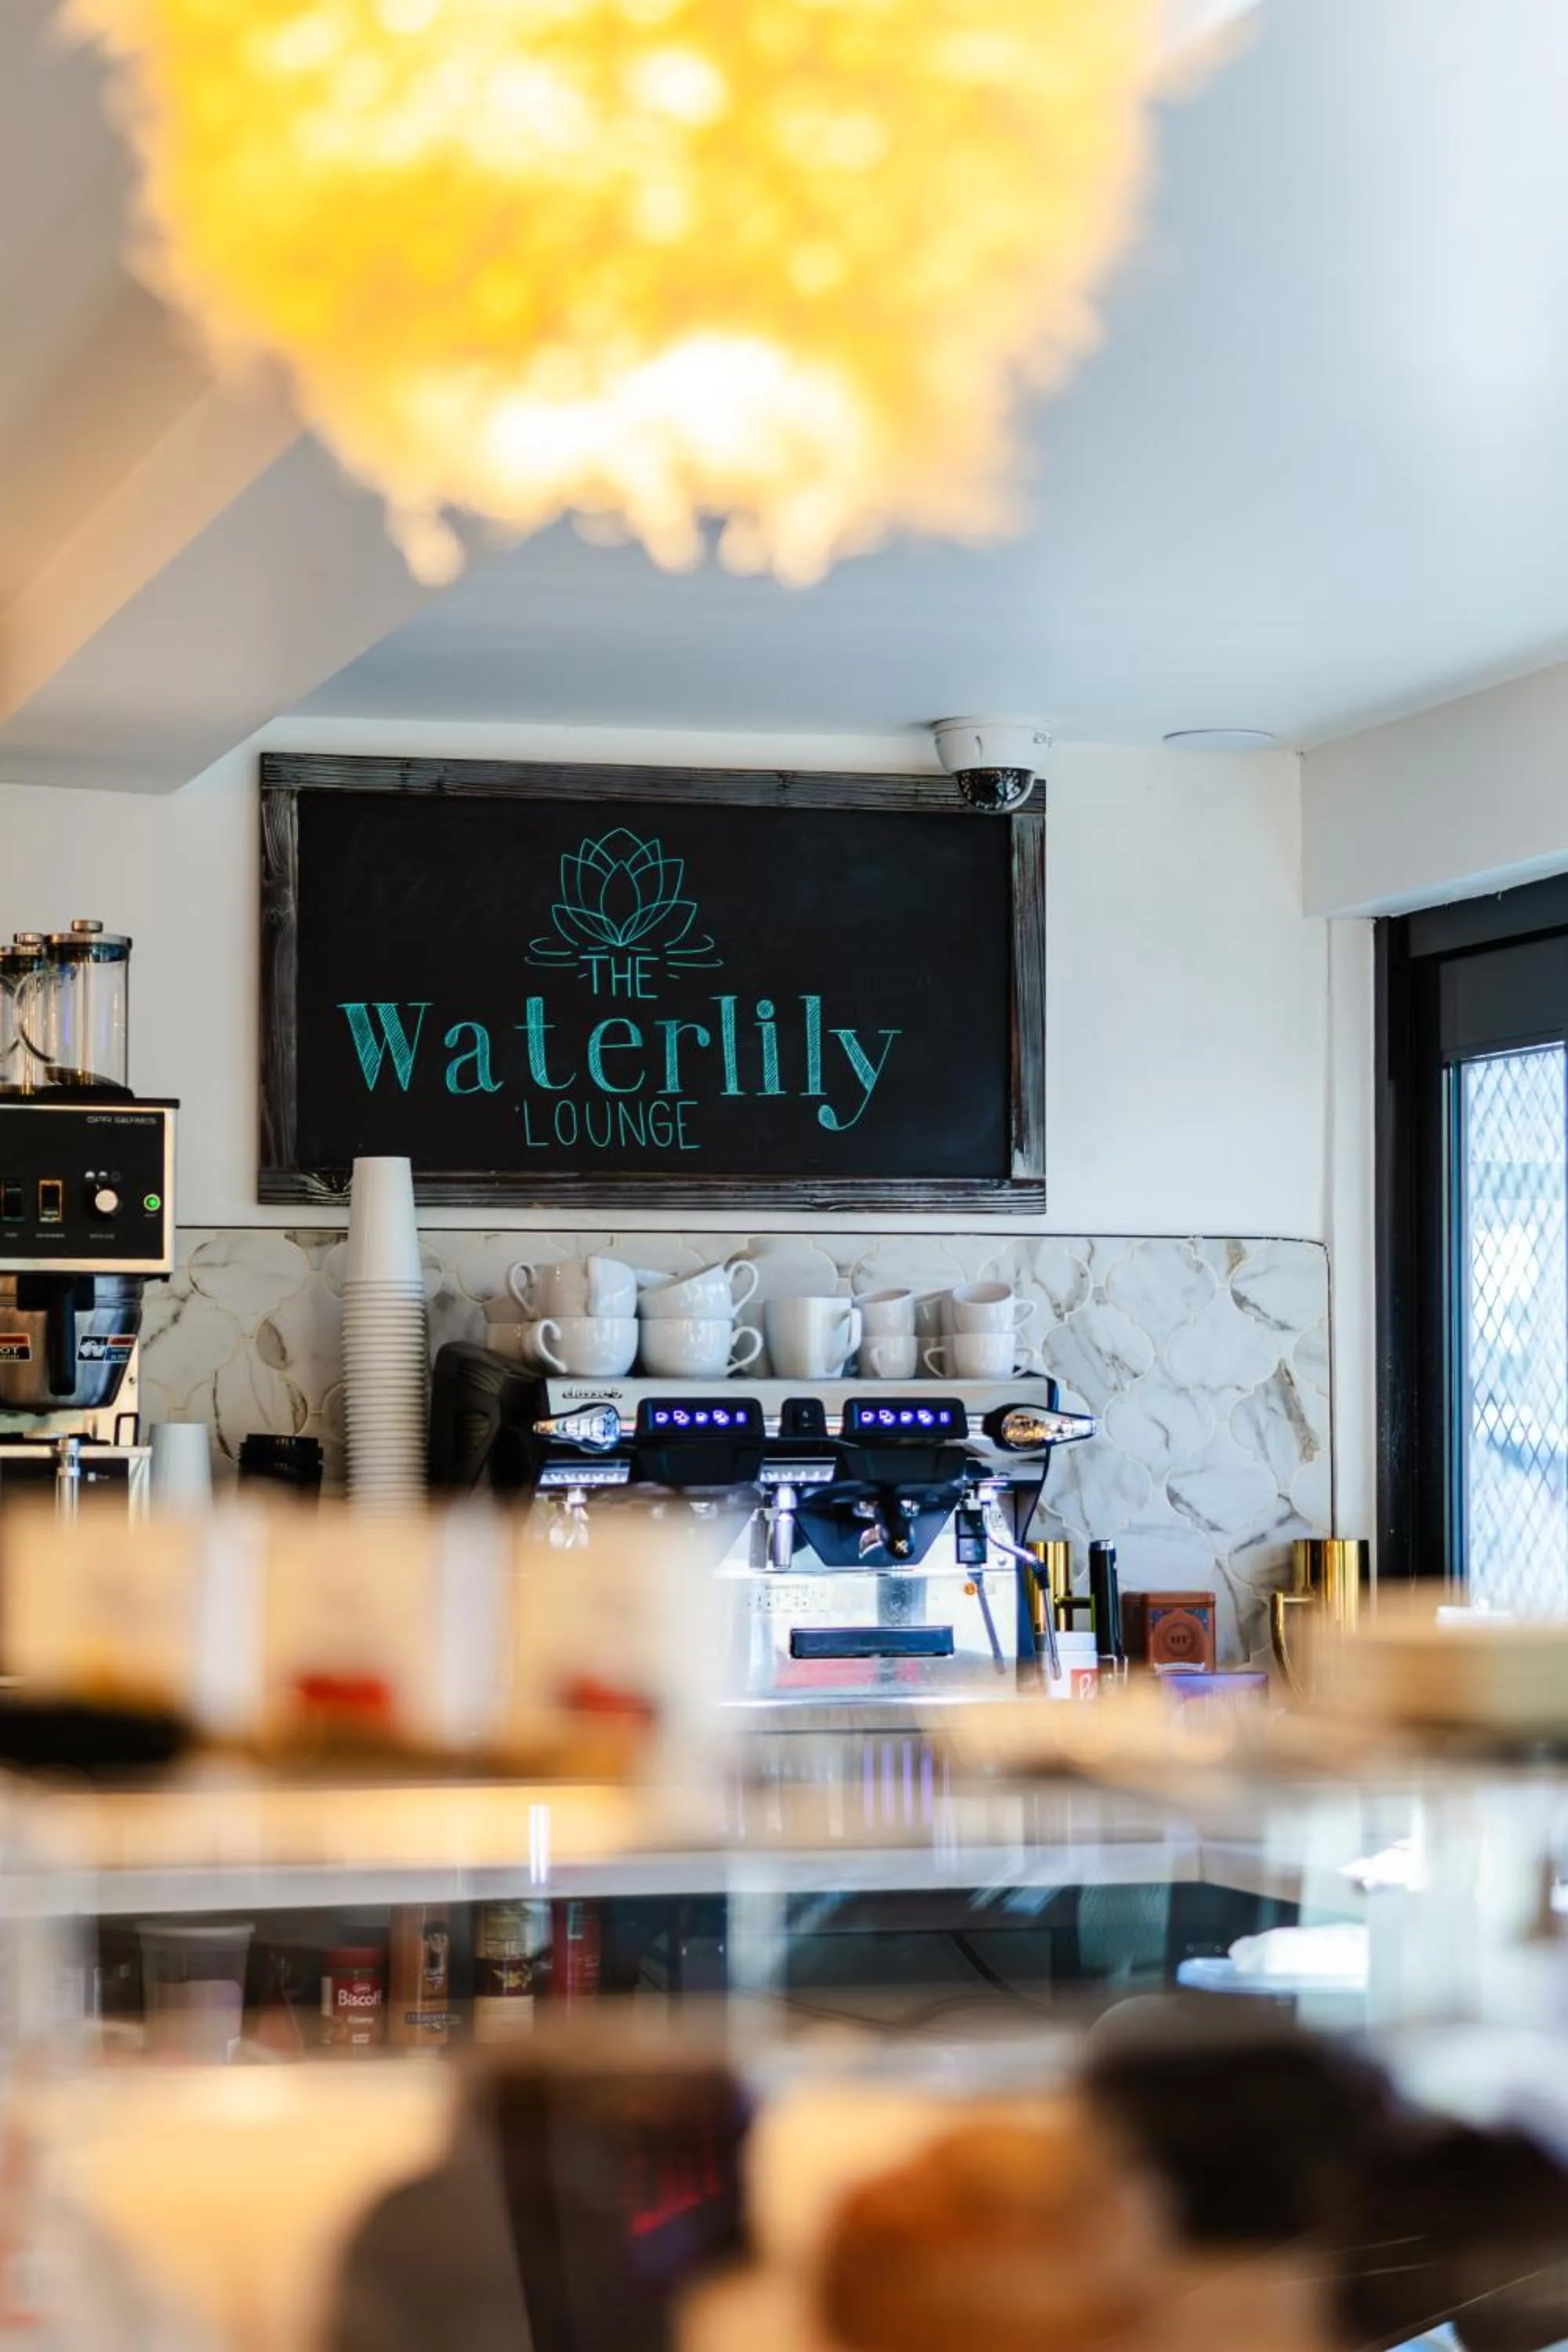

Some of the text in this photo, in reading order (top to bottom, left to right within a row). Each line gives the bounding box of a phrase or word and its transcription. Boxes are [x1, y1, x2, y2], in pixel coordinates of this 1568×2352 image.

[579, 953, 660, 999] THE
[337, 993, 902, 1131] Waterlily
[522, 1099, 702, 1150] LOUNGE
